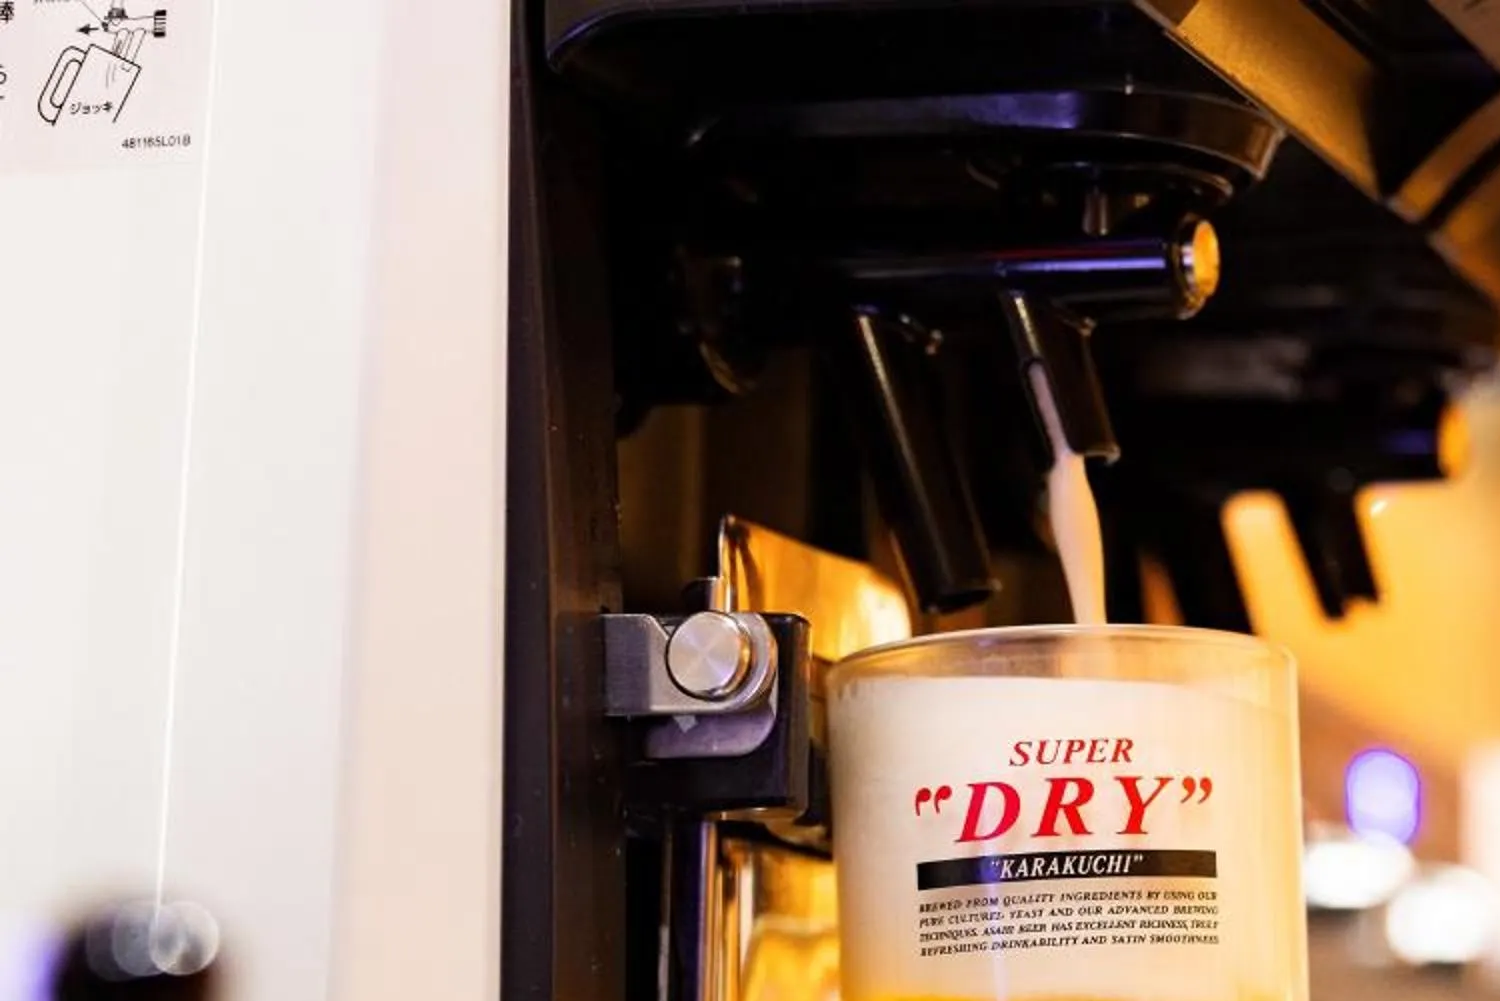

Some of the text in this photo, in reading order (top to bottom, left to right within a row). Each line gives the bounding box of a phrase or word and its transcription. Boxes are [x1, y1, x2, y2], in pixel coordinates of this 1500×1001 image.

[1009, 737, 1134, 767] SUPER
[919, 890, 1217, 912] BREWED FROM QUALITY INGREDIENTS BY USING OUR
[919, 916, 945, 928] PURE
[1009, 908, 1045, 919] YEAST
[1048, 907, 1073, 917] AND
[1078, 905, 1102, 916] OUR
[1108, 905, 1168, 915] ADVANCED
[1173, 904, 1218, 914] BREWING
[982, 925, 1014, 936] ASAHI
[1018, 923, 1046, 933] BEER
[1051, 921, 1072, 931] HAS
[1075, 919, 1136, 930] EXCELLENT
[1190, 918, 1218, 929] TRULY
[920, 934, 1219, 956] REFRESHING DRINKABILITY AND SATIN SMOOTHNESS
